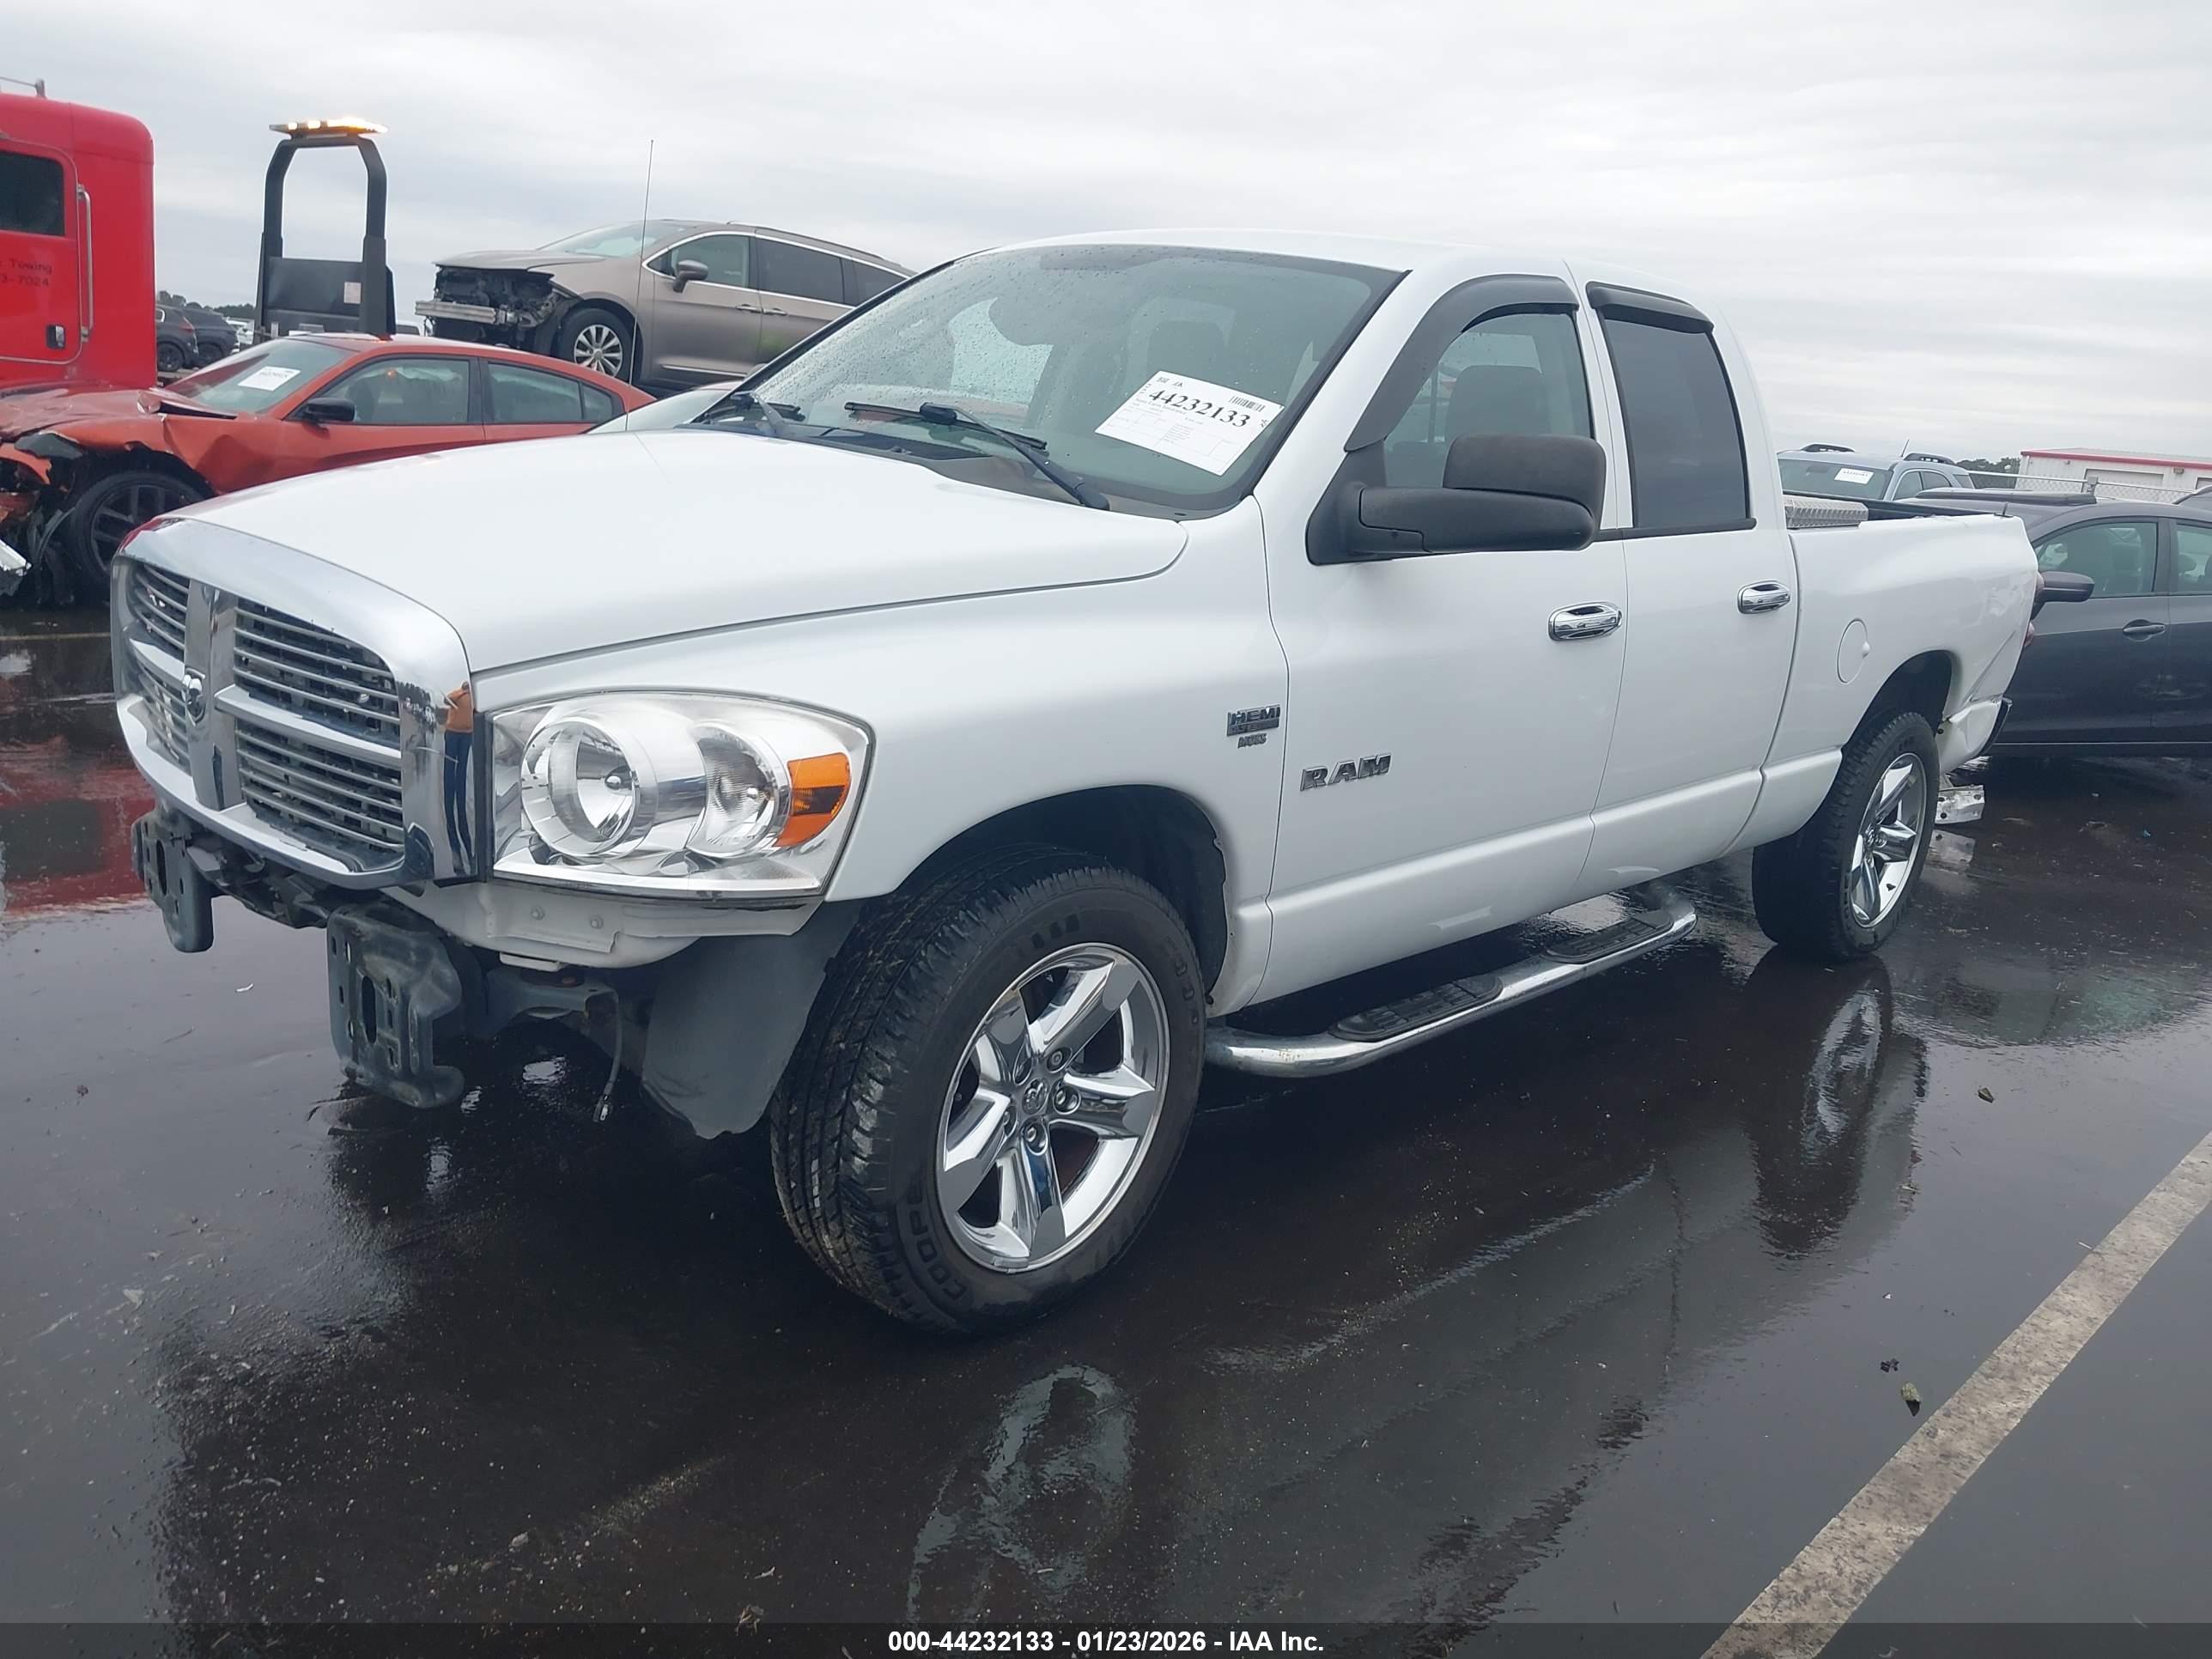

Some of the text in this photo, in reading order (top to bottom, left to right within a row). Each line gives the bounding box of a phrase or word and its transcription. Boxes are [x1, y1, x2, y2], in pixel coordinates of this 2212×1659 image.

[9, 258, 52, 276] Towing
[1149, 390, 1251, 428] 44232133
[1229, 706, 1281, 726] HEMI
[1300, 753, 1391, 792] RAM
